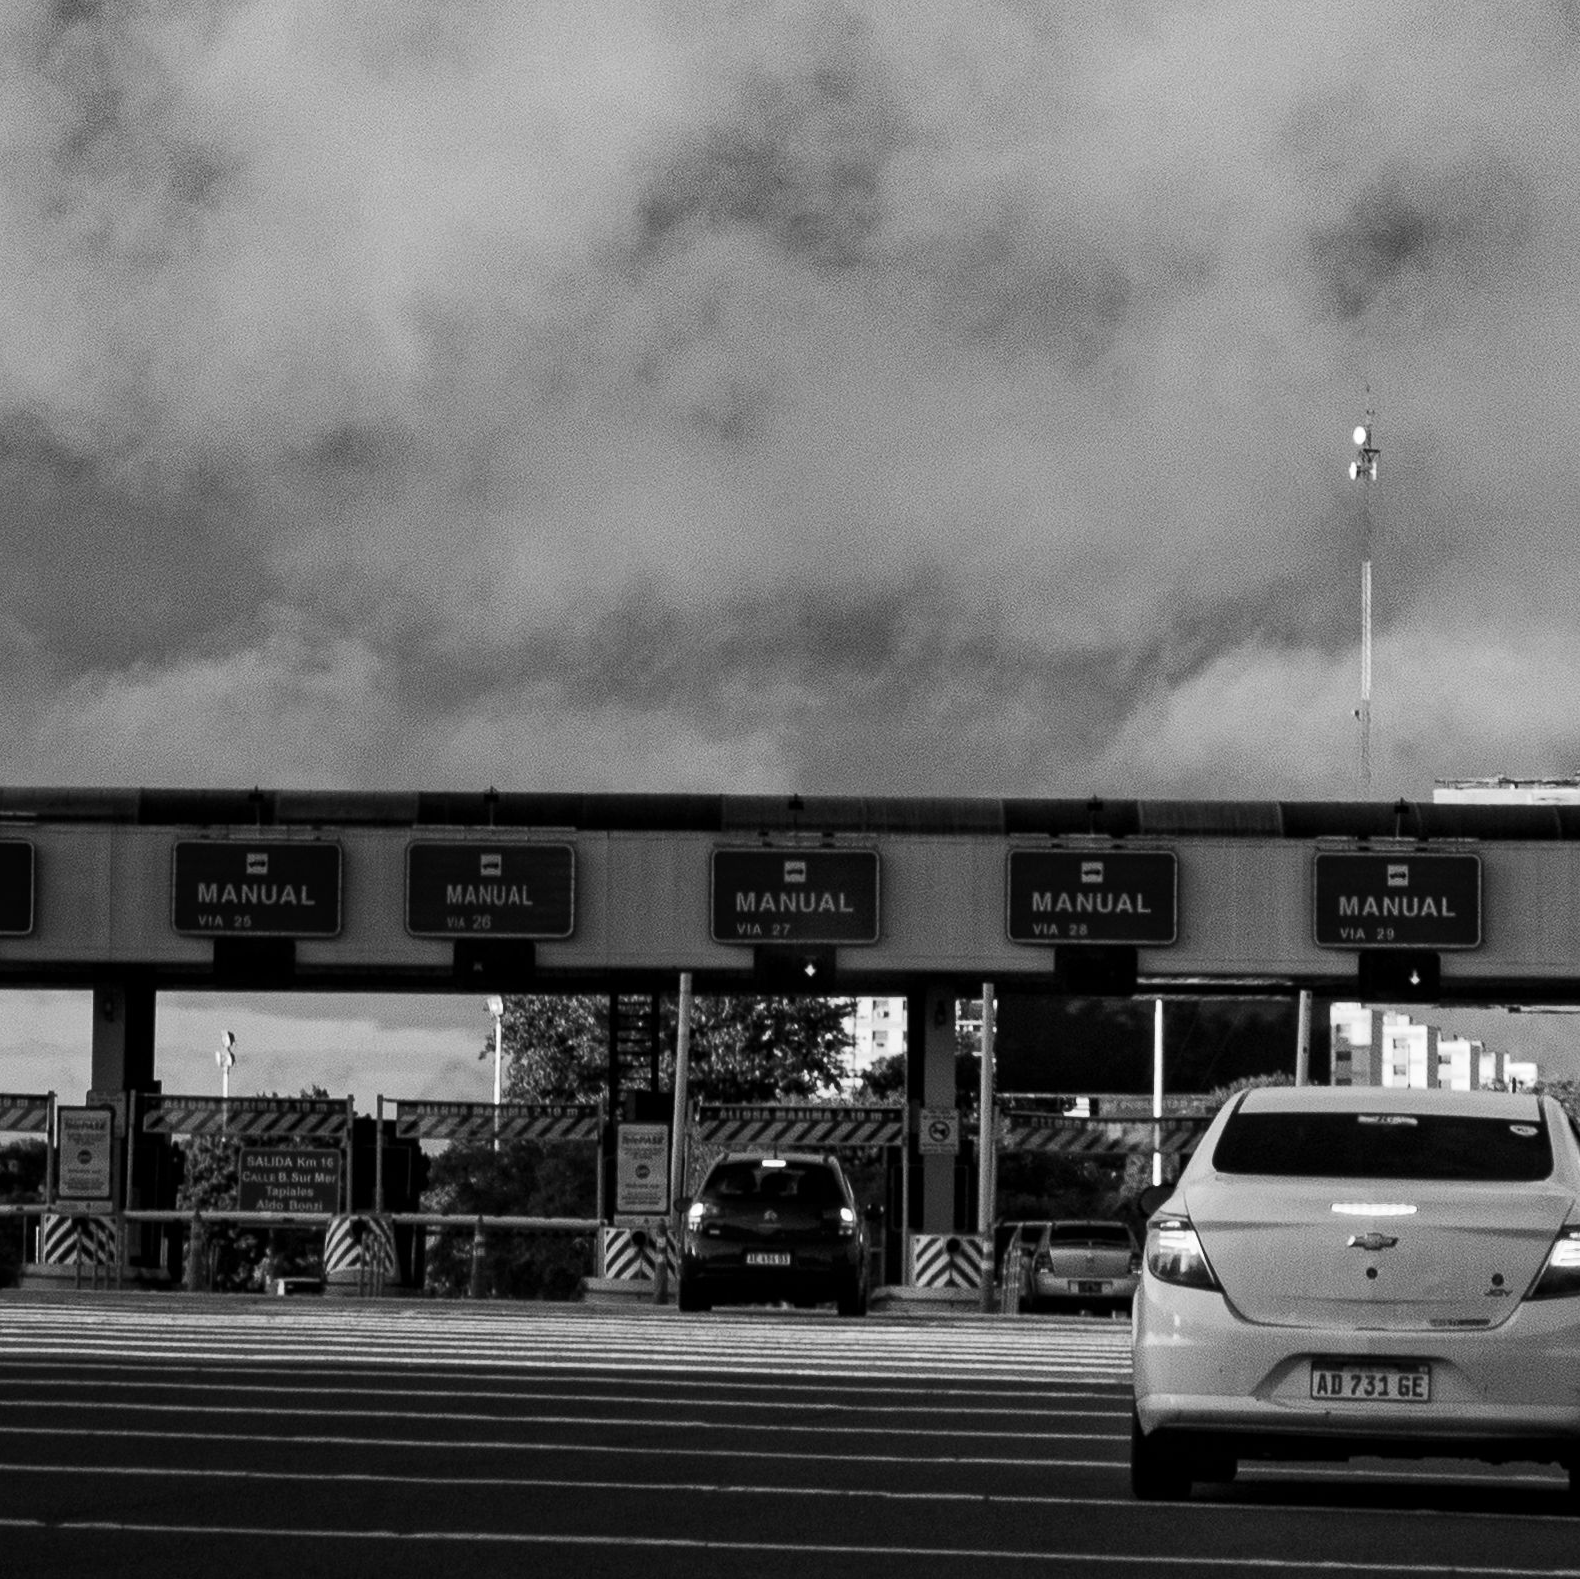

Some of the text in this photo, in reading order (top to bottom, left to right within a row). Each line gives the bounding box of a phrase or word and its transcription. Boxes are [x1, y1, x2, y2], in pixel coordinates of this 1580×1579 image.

[197, 883, 316, 906] MANUAL
[446, 884, 533, 906] MANUAL
[736, 892, 854, 914] MANUAL
[1032, 891, 1152, 914] MANUAL
[1338, 896, 1457, 918] MANUAL
[198, 914, 224, 928] VIA
[447, 914, 492, 930] VIA 26
[737, 923, 791, 936] VIA 27
[1033, 923, 1089, 936] VIA 28
[1339, 928, 1395, 941] VIA 29
[247, 1156, 334, 1168] SALIDA Km 16
[243, 1171, 276, 1182] CALLE
[291, 1172, 311, 1183] Sur
[314, 1172, 337, 1184] Mer
[266, 1185, 314, 1198] Tapiales
[255, 1198, 323, 1212] Aldo Bonzi
[1317, 1373, 1425, 1398] AD 731 GE
